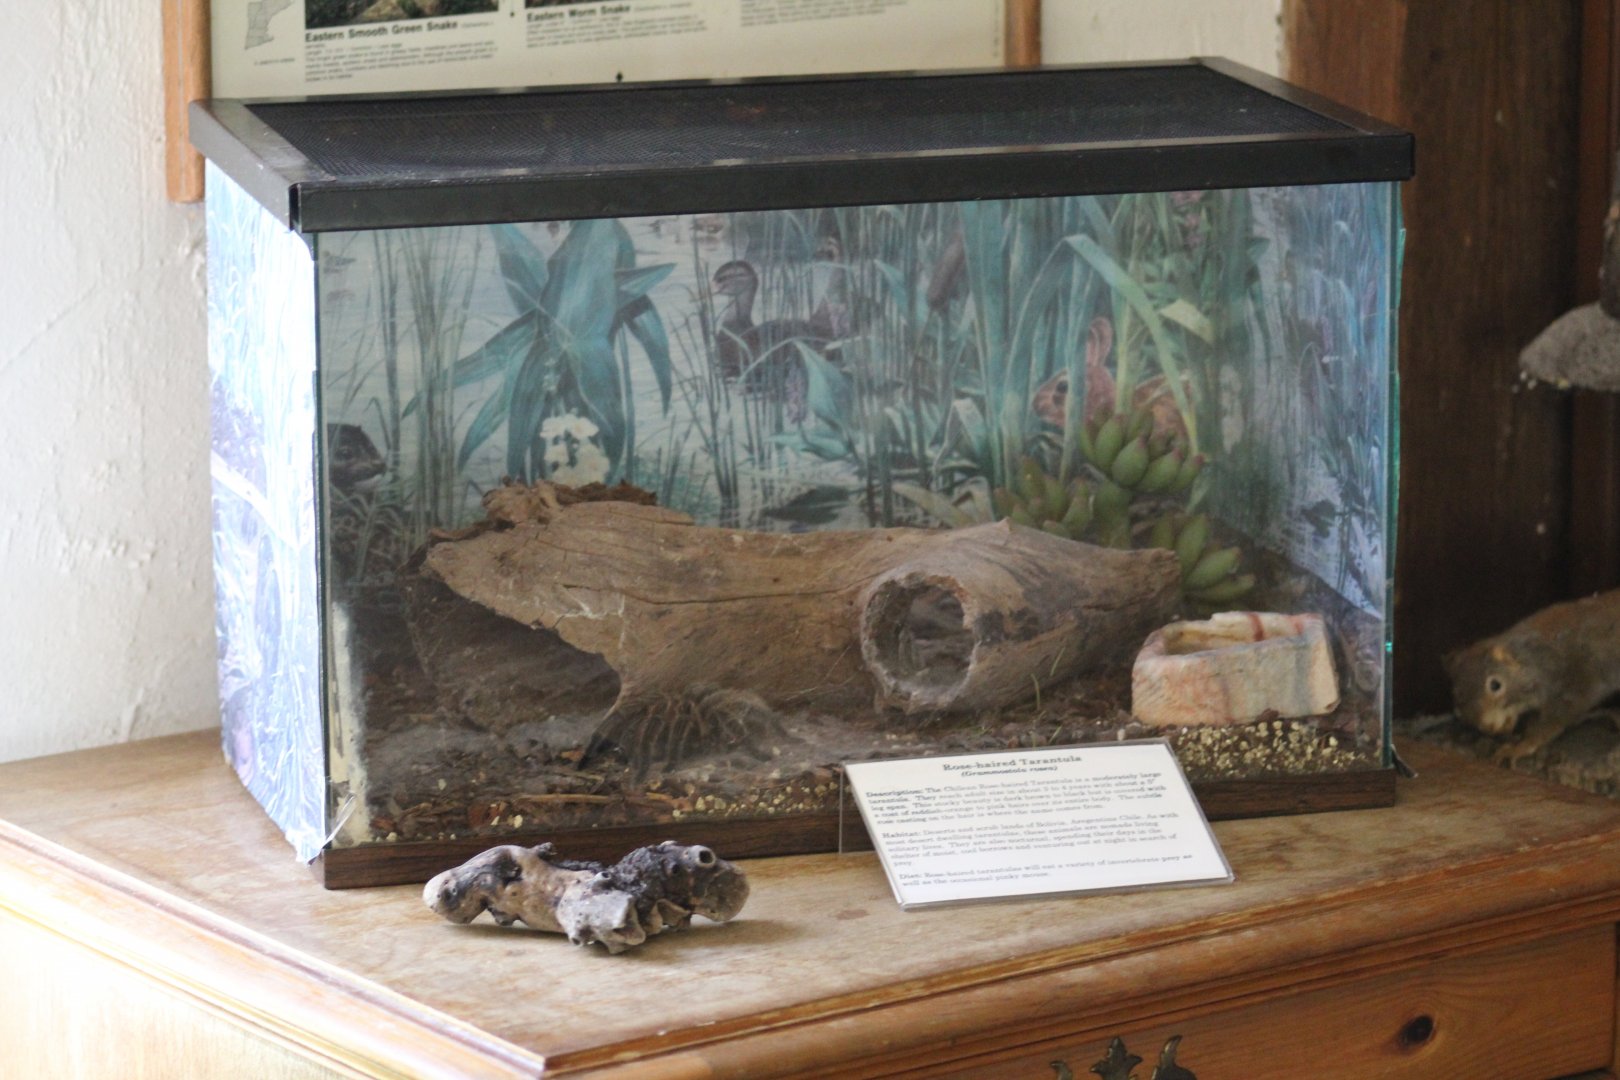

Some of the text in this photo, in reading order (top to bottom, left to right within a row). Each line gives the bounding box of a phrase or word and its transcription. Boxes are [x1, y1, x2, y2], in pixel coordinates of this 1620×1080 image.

[527, 11, 564, 22] Eastern
[600, 4, 631, 15] Snake
[305, 31, 344, 42] Eastern
[349, 27, 388, 38] Smooth
[391, 23, 423, 34] Green
[426, 20, 458, 32] Snake
[1019, 755, 1082, 766] Tarantula
